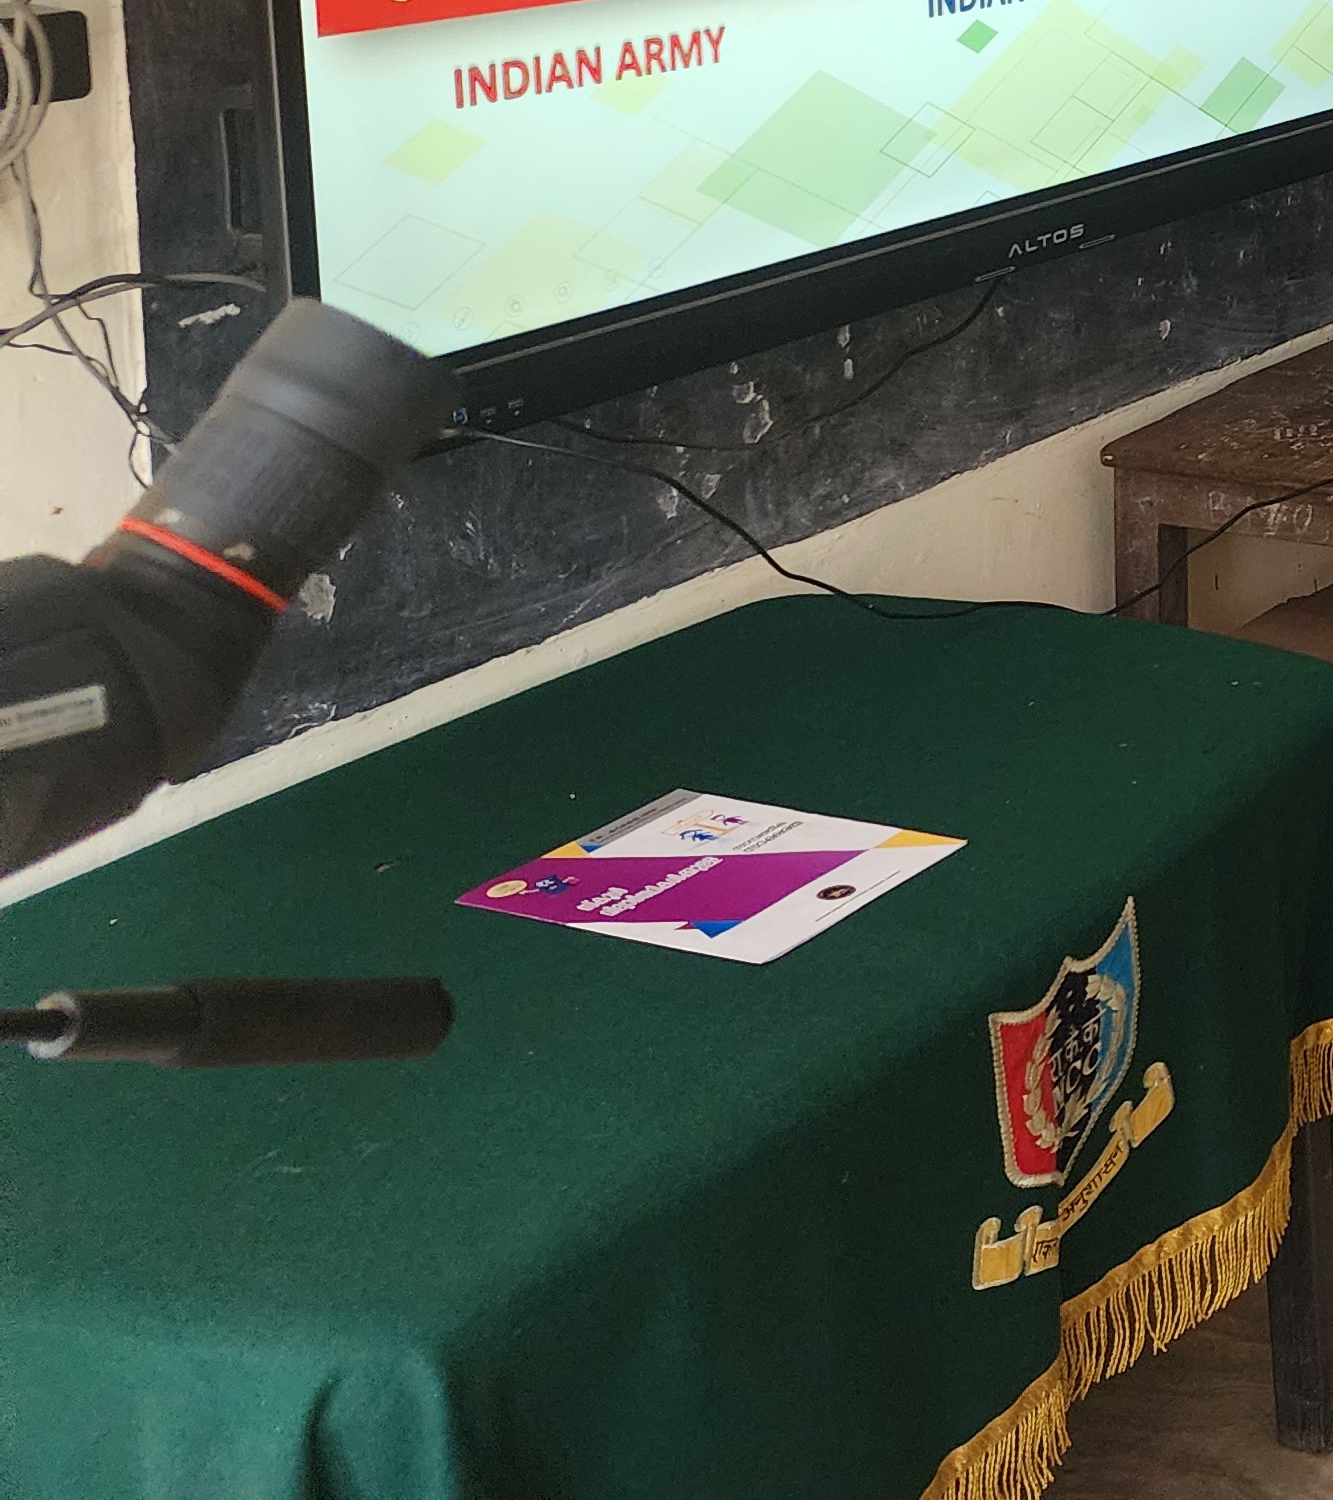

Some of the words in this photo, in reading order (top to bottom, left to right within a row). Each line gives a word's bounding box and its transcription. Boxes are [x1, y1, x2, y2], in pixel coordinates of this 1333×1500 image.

[453, 44, 604, 110] INDIAN
[614, 25, 728, 82] ARMY
[1008, 223, 1085, 259] ALTOS
